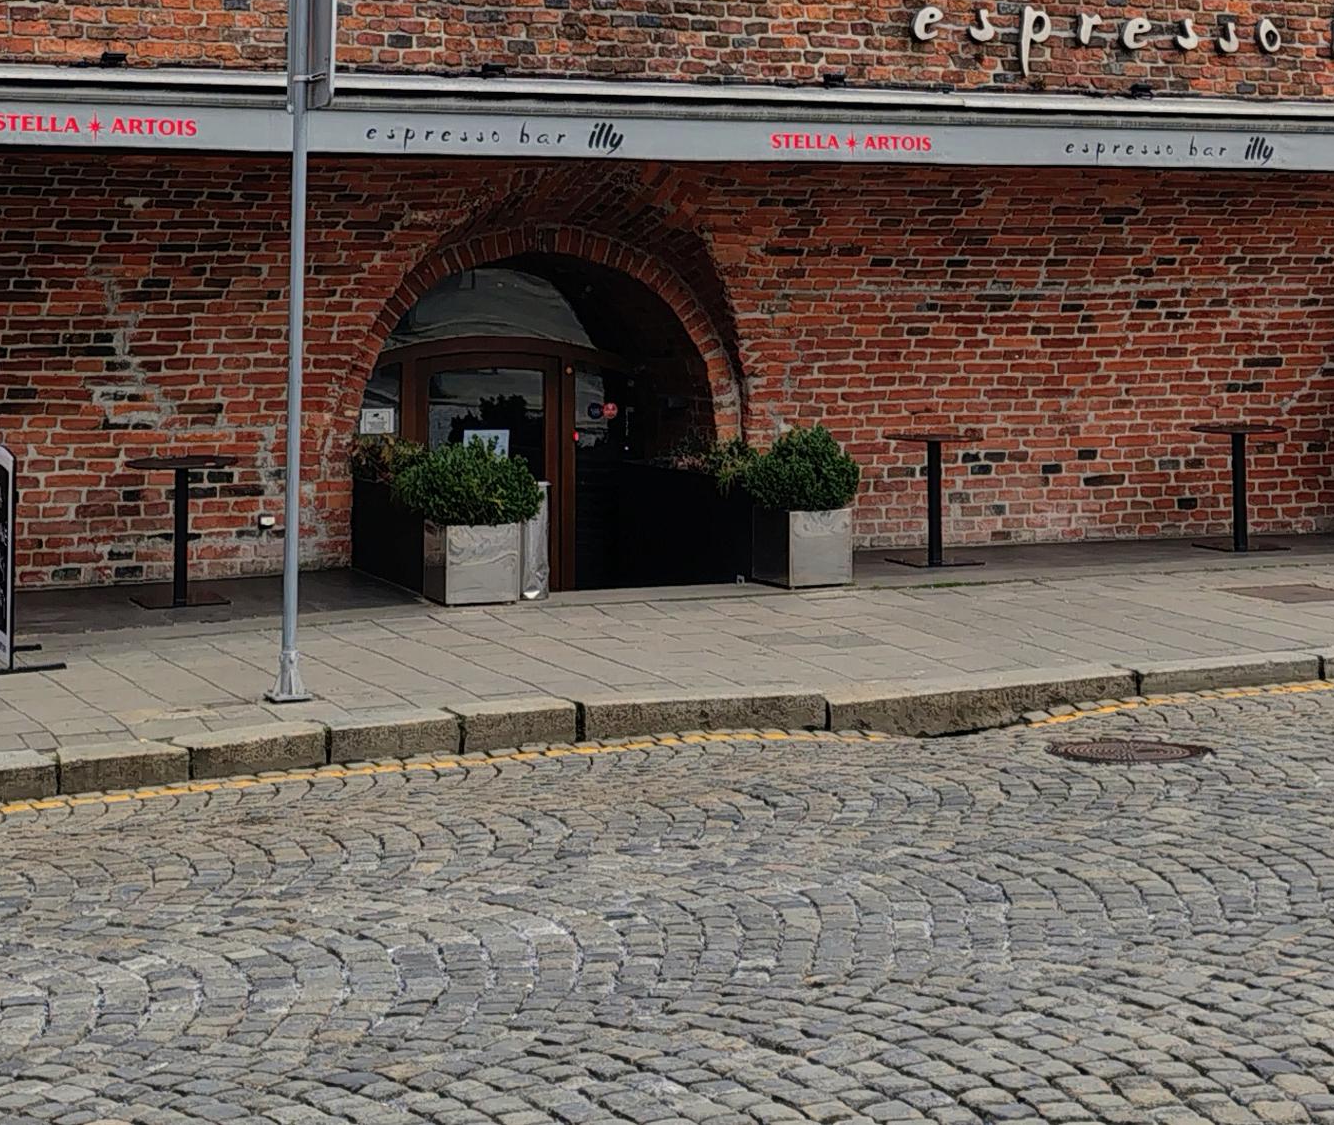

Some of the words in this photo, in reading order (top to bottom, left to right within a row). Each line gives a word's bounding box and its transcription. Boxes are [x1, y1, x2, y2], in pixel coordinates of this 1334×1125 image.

[910, 4, 1282, 76] espresso
[111, 117, 198, 137] ARTOIS
[365, 126, 500, 152] espresso
[519, 121, 567, 145] bar
[587, 122, 625, 155] illy
[770, 132, 840, 150] STELLA
[863, 134, 932, 152] ARTOIS
[1064, 141, 1174, 163] espresso
[1188, 135, 1227, 157] bar
[1244, 136, 1275, 166] illy
